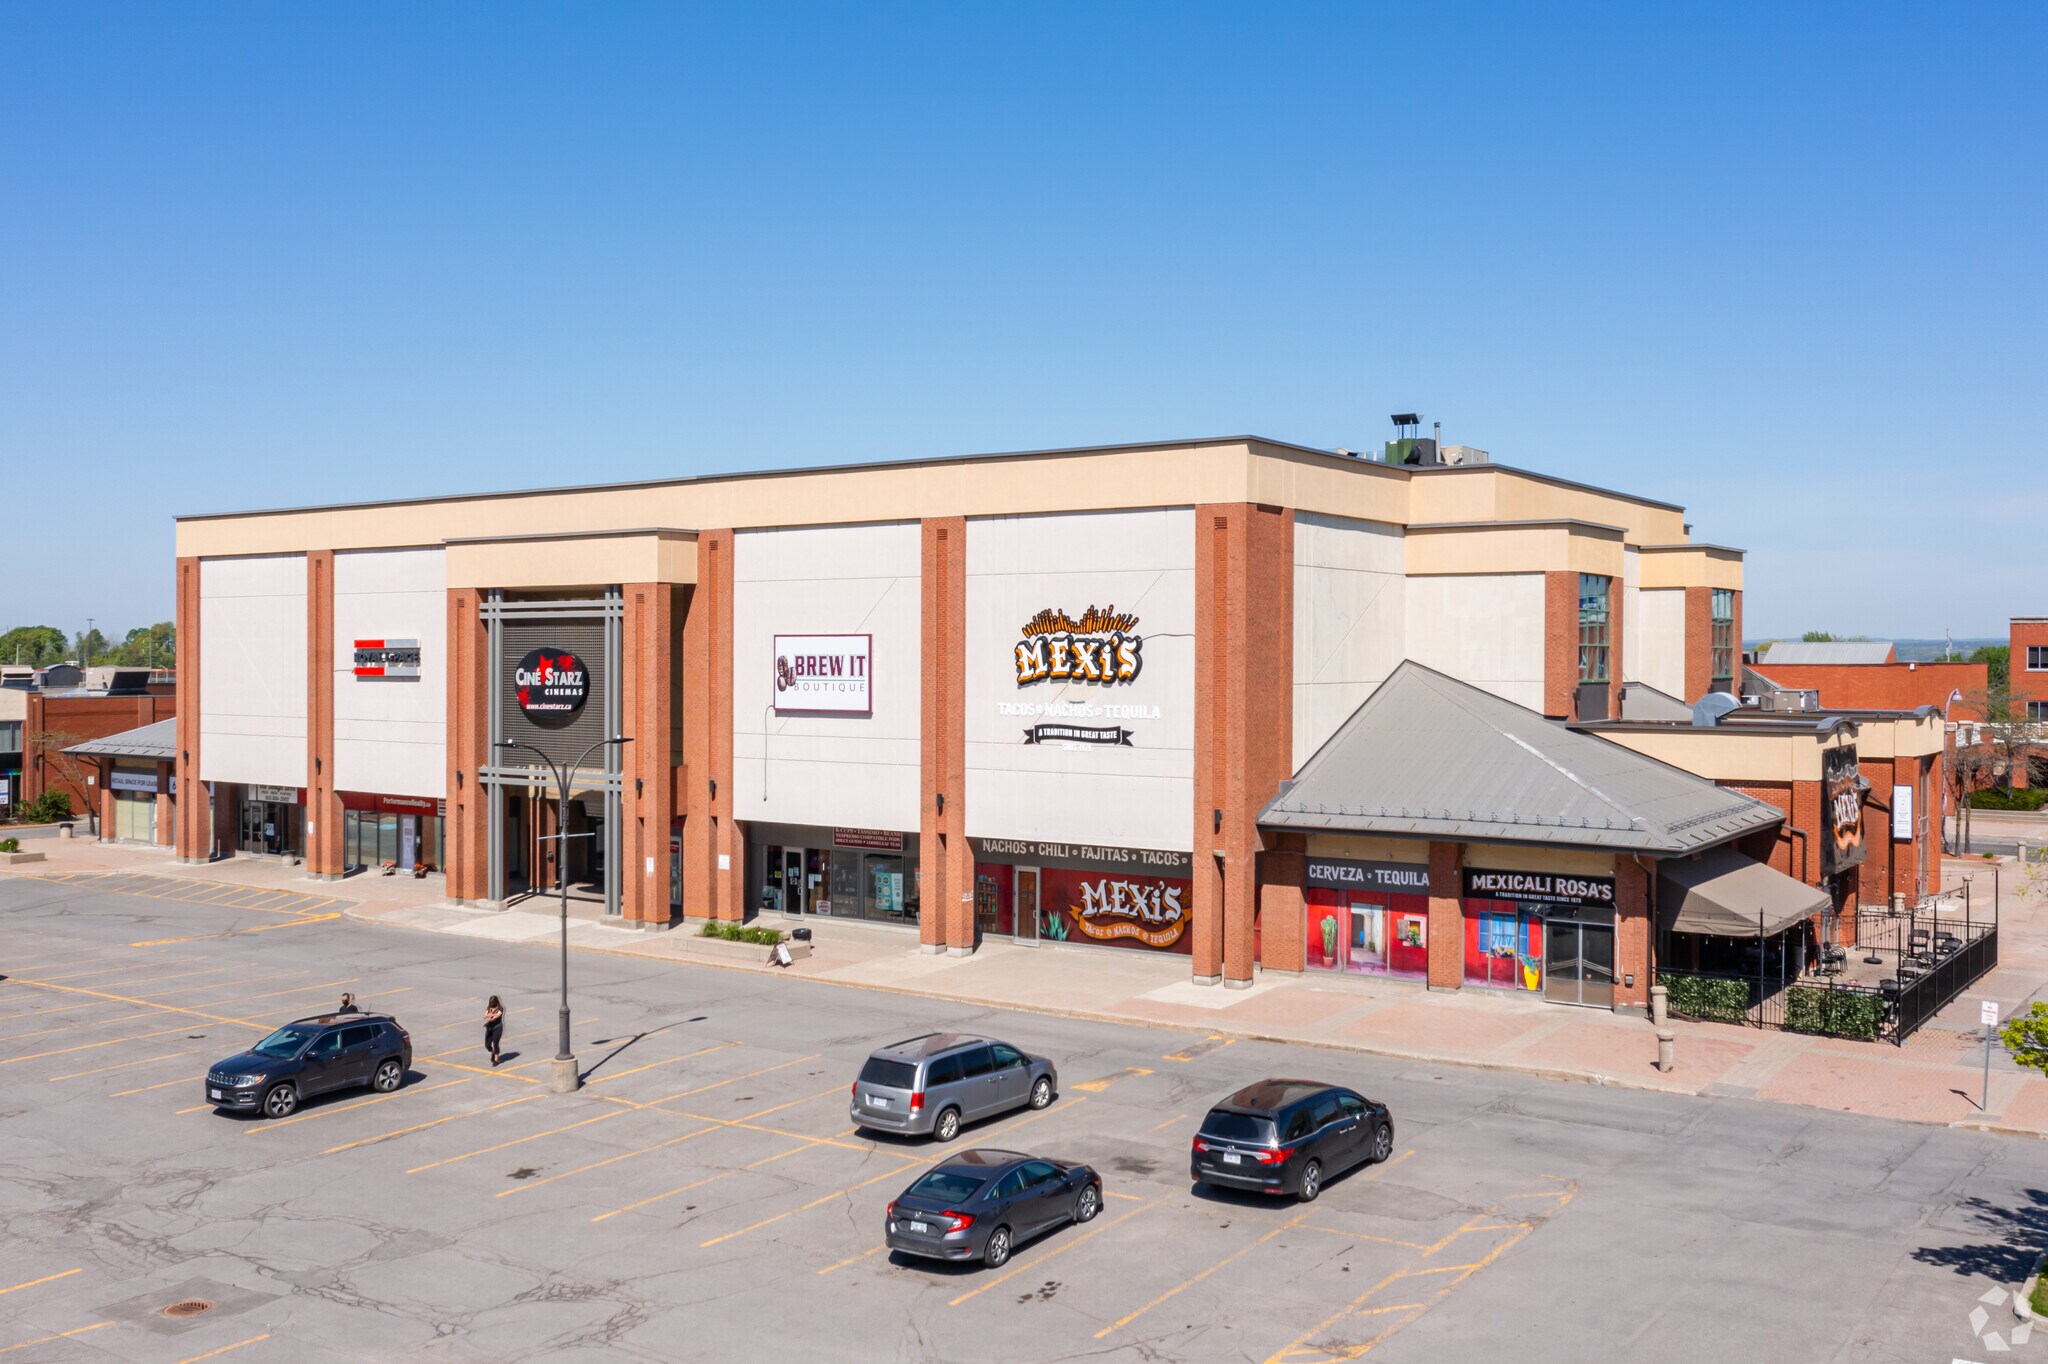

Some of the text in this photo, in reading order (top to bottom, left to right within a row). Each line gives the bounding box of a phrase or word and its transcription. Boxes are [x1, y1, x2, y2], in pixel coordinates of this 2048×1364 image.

[795, 655, 866, 676] BREW IT
[544, 688, 584, 696] CINEMAS
[794, 683, 865, 693] BOUTIQUE
[999, 703, 1161, 720] TACOS NACHOS TEQUILA
[1038, 728, 1118, 739] A TRADITION IN GREAT TASTE
[982, 839, 1180, 866] NACHOS CHILI FAJITAS TACOS
[1308, 864, 1430, 887] CERVEZA TEQUILA
[1472, 874, 1613, 900] MEXICALI ROSA'S
[1085, 923, 1179, 944] TACOS NACHOS TEQUILA
